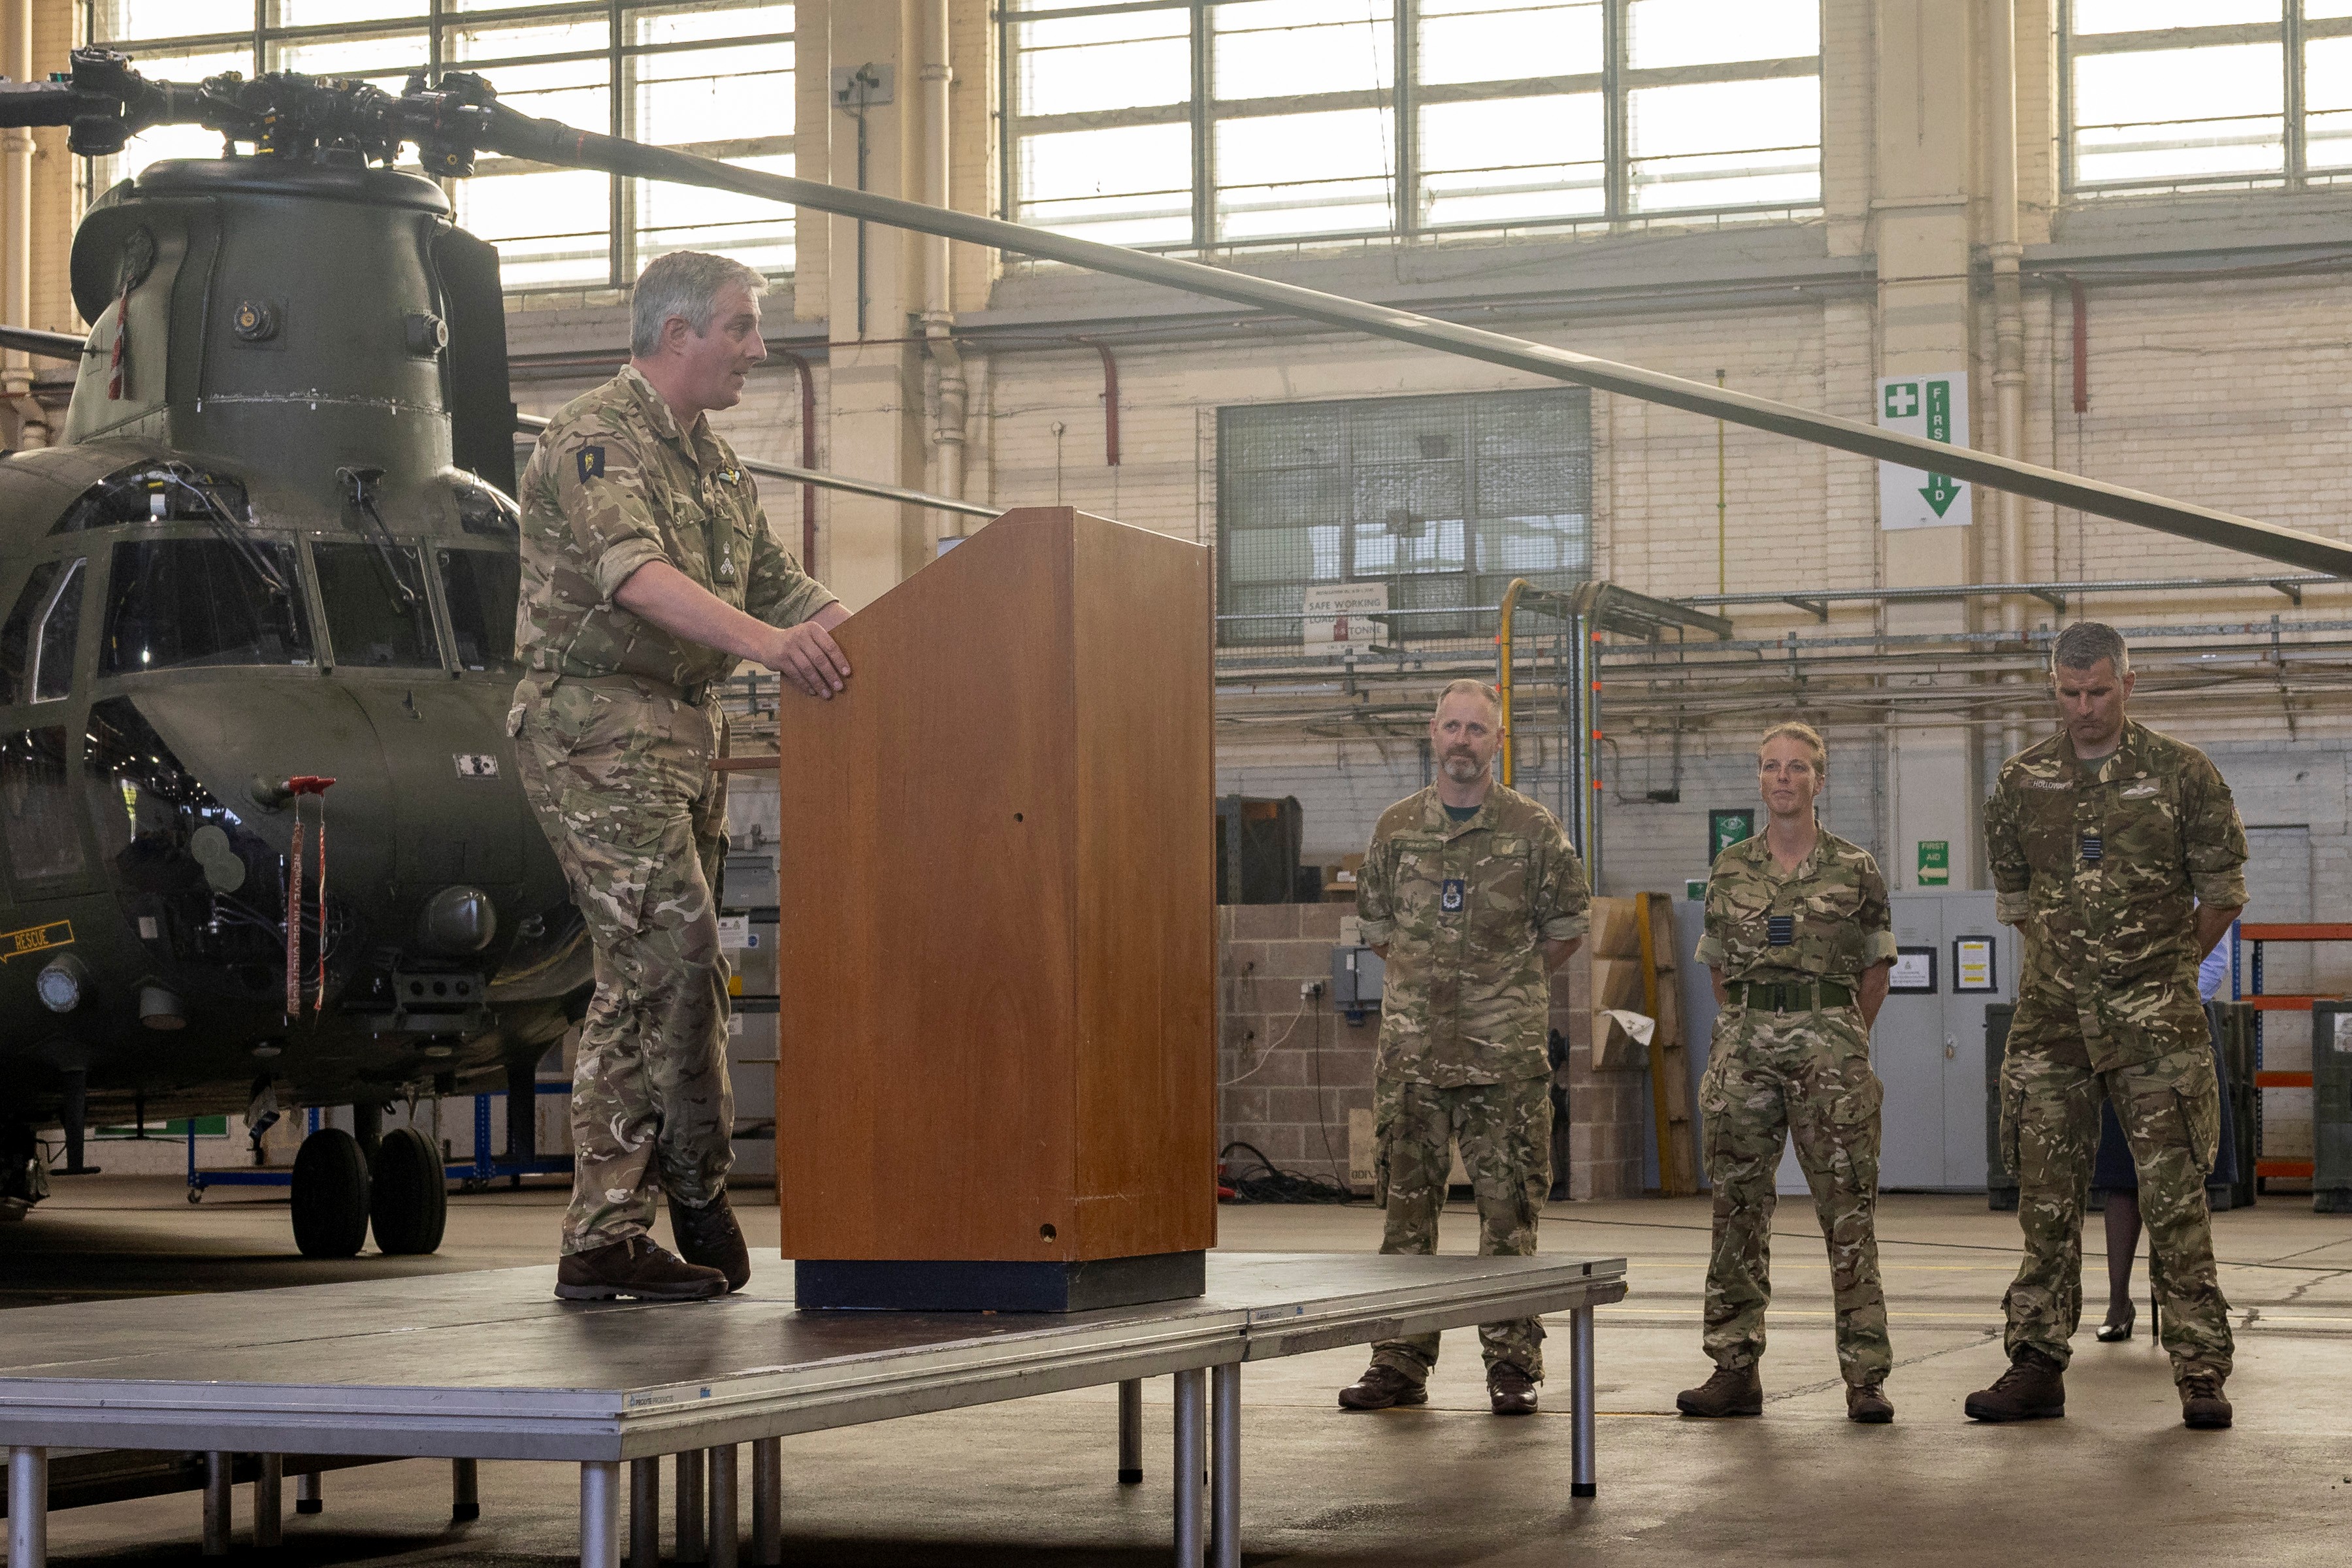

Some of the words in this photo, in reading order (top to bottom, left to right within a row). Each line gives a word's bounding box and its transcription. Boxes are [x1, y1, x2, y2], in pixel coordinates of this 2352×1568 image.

[1933, 387, 1944, 440] FIRS
[1934, 476, 1945, 502] ID
[1309, 601, 1331, 610] SAFE
[1335, 598, 1381, 608] WORKING
[1348, 625, 1382, 635] TONNE
[14, 928, 50, 952] RESCUE
